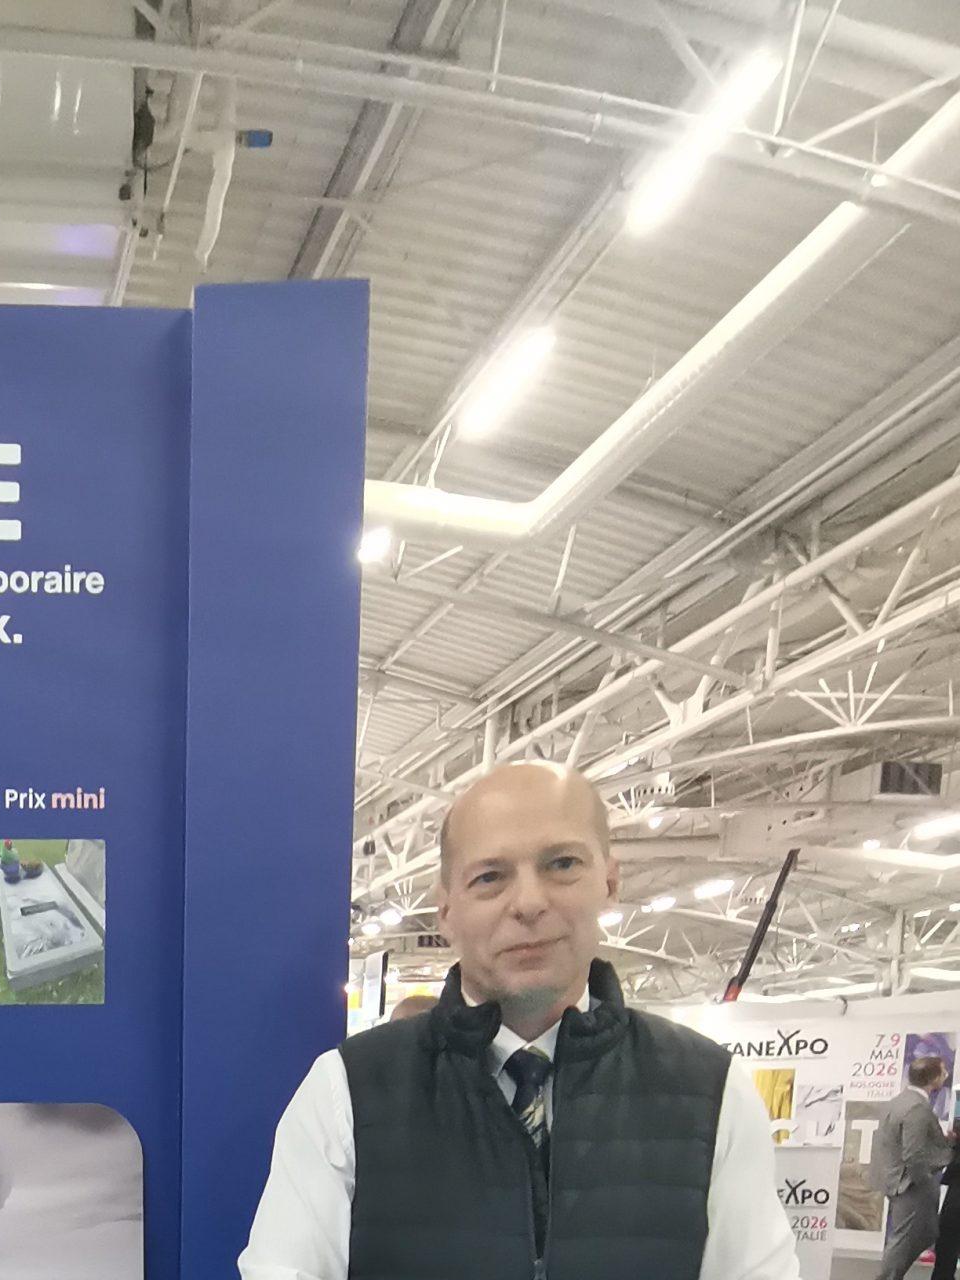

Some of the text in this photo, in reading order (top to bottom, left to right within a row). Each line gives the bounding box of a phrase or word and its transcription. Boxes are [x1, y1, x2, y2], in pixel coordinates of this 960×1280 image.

[5, 787, 46, 809] Prix
[51, 787, 105, 809] mini
[870, 1049, 899, 1060] MAI
[852, 1062, 897, 1077] 2026
[791, 1215, 828, 1229] 2026
[796, 1230, 827, 1241] TALIE
